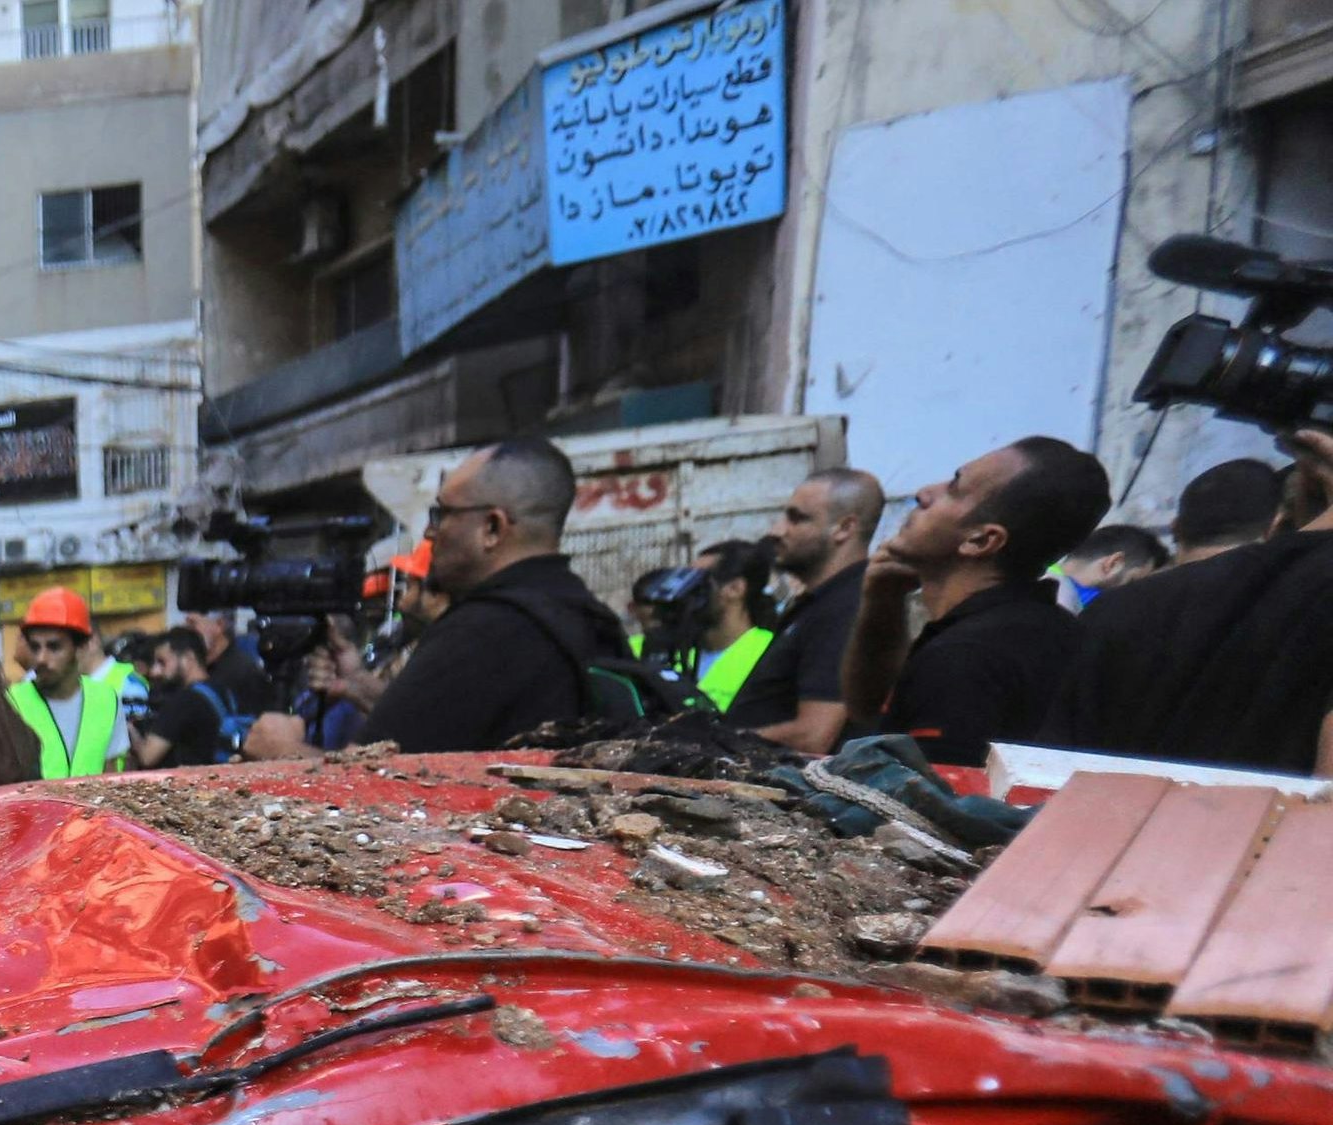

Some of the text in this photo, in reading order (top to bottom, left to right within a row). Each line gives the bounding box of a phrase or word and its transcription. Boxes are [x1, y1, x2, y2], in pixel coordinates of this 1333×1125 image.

[551, 52, 773, 140] قطع سيارات يابانية
